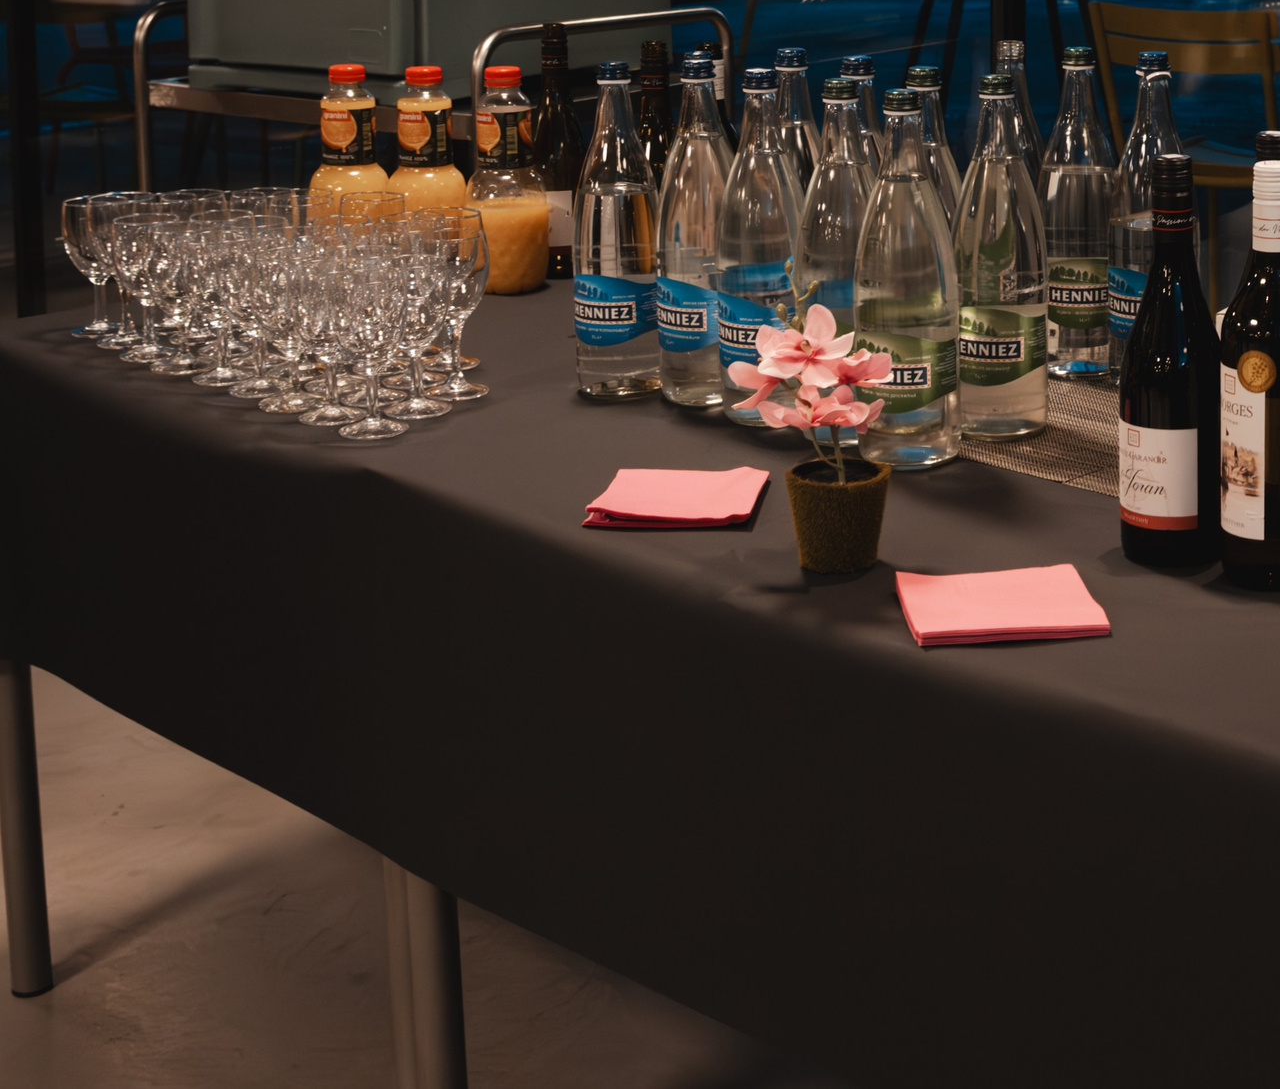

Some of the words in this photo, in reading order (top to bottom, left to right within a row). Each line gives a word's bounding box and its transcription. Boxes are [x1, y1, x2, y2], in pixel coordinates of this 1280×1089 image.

[1051, 289, 1107, 302] HENNIE
[657, 307, 700, 326] ENNIEZ
[960, 341, 1018, 357] ENNIEZ
[1222, 397, 1254, 418] ORGES
